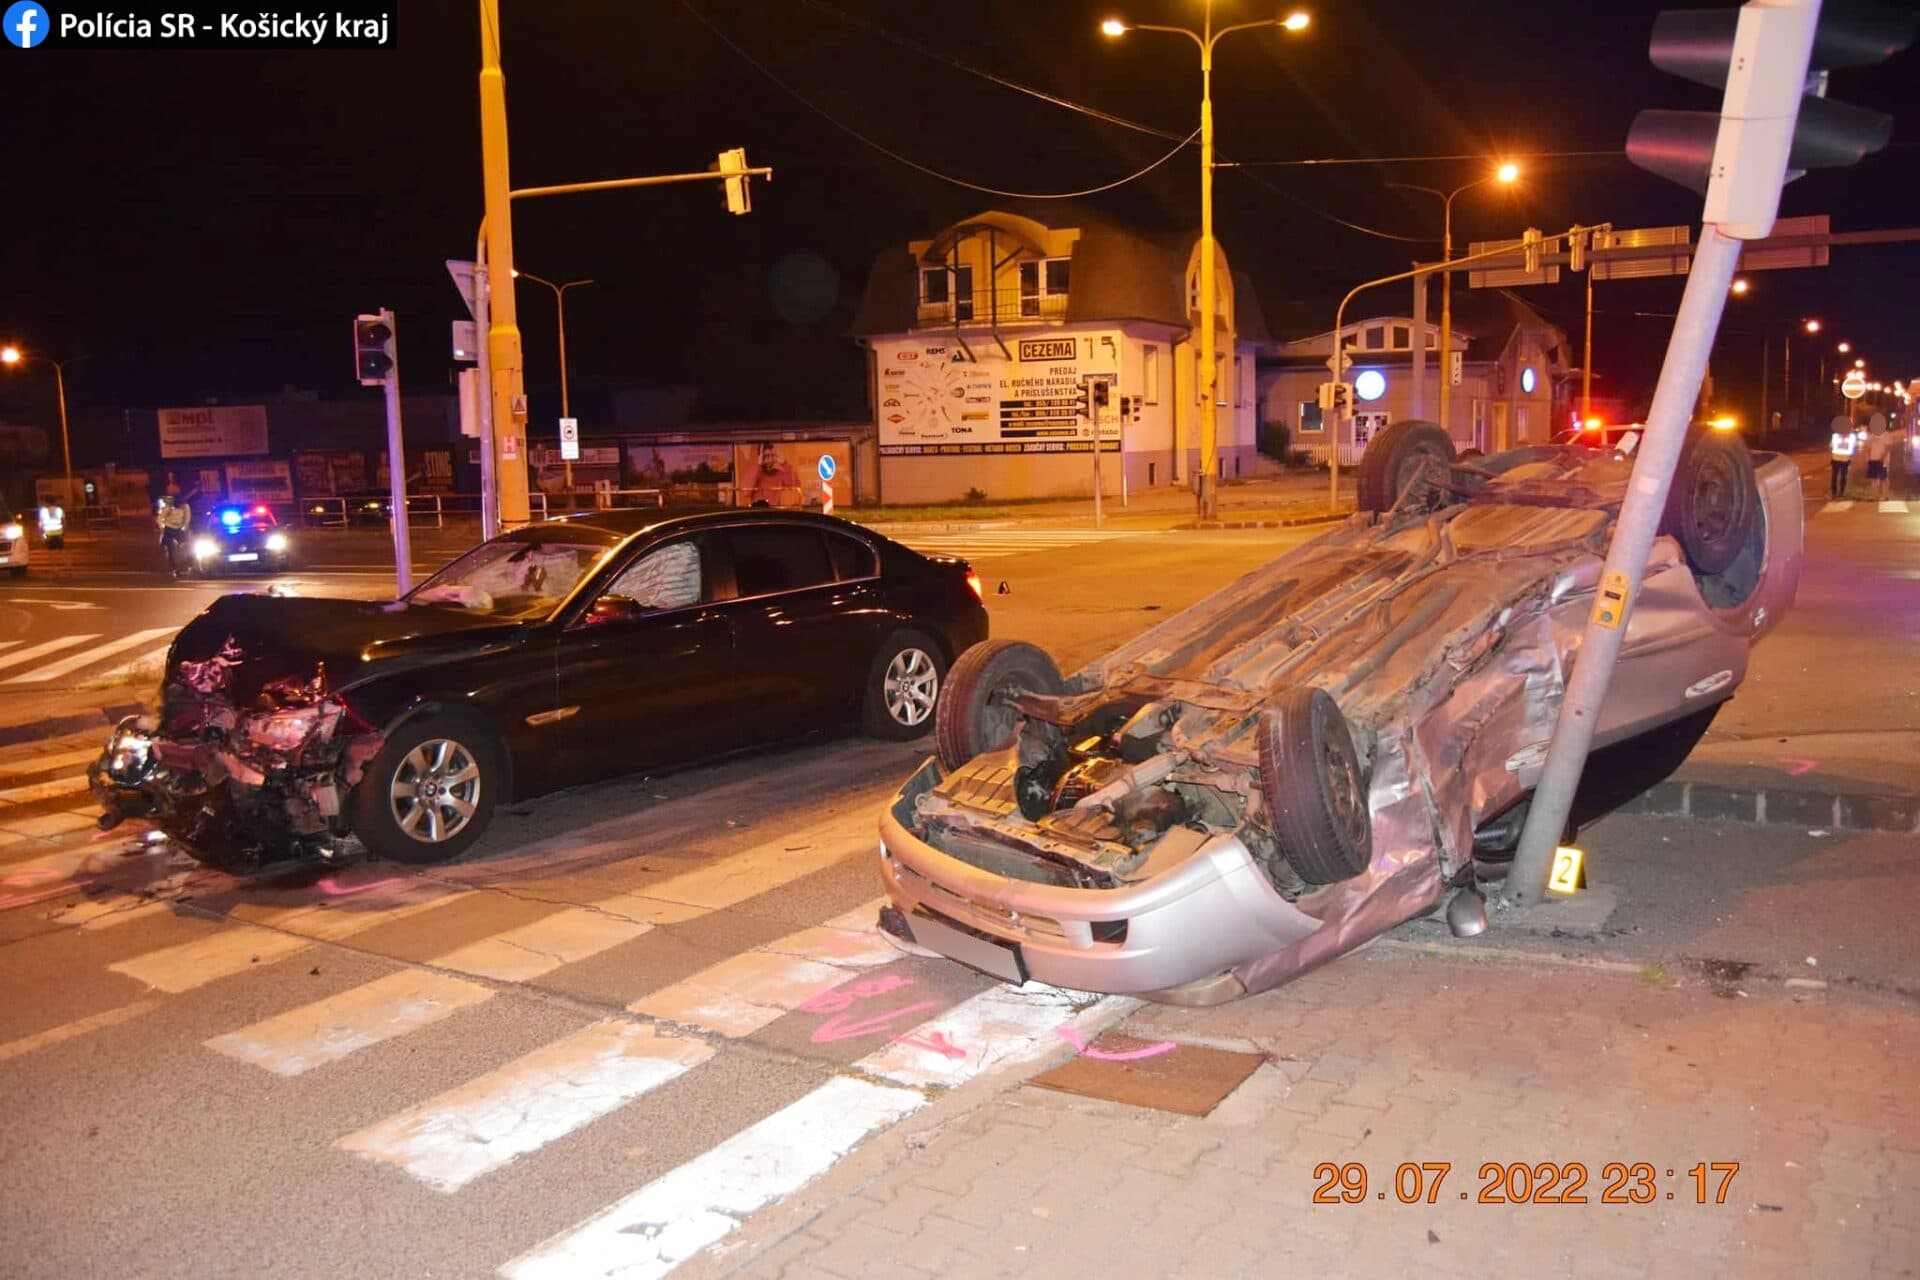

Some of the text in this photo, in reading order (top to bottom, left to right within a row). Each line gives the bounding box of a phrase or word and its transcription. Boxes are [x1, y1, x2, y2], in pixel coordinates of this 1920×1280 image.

[1023, 343, 1072, 358] CEZEMA
[1049, 367, 1077, 375] PREDAJ
[503, 435, 515, 452] H
[1554, 855, 1573, 885] 2
